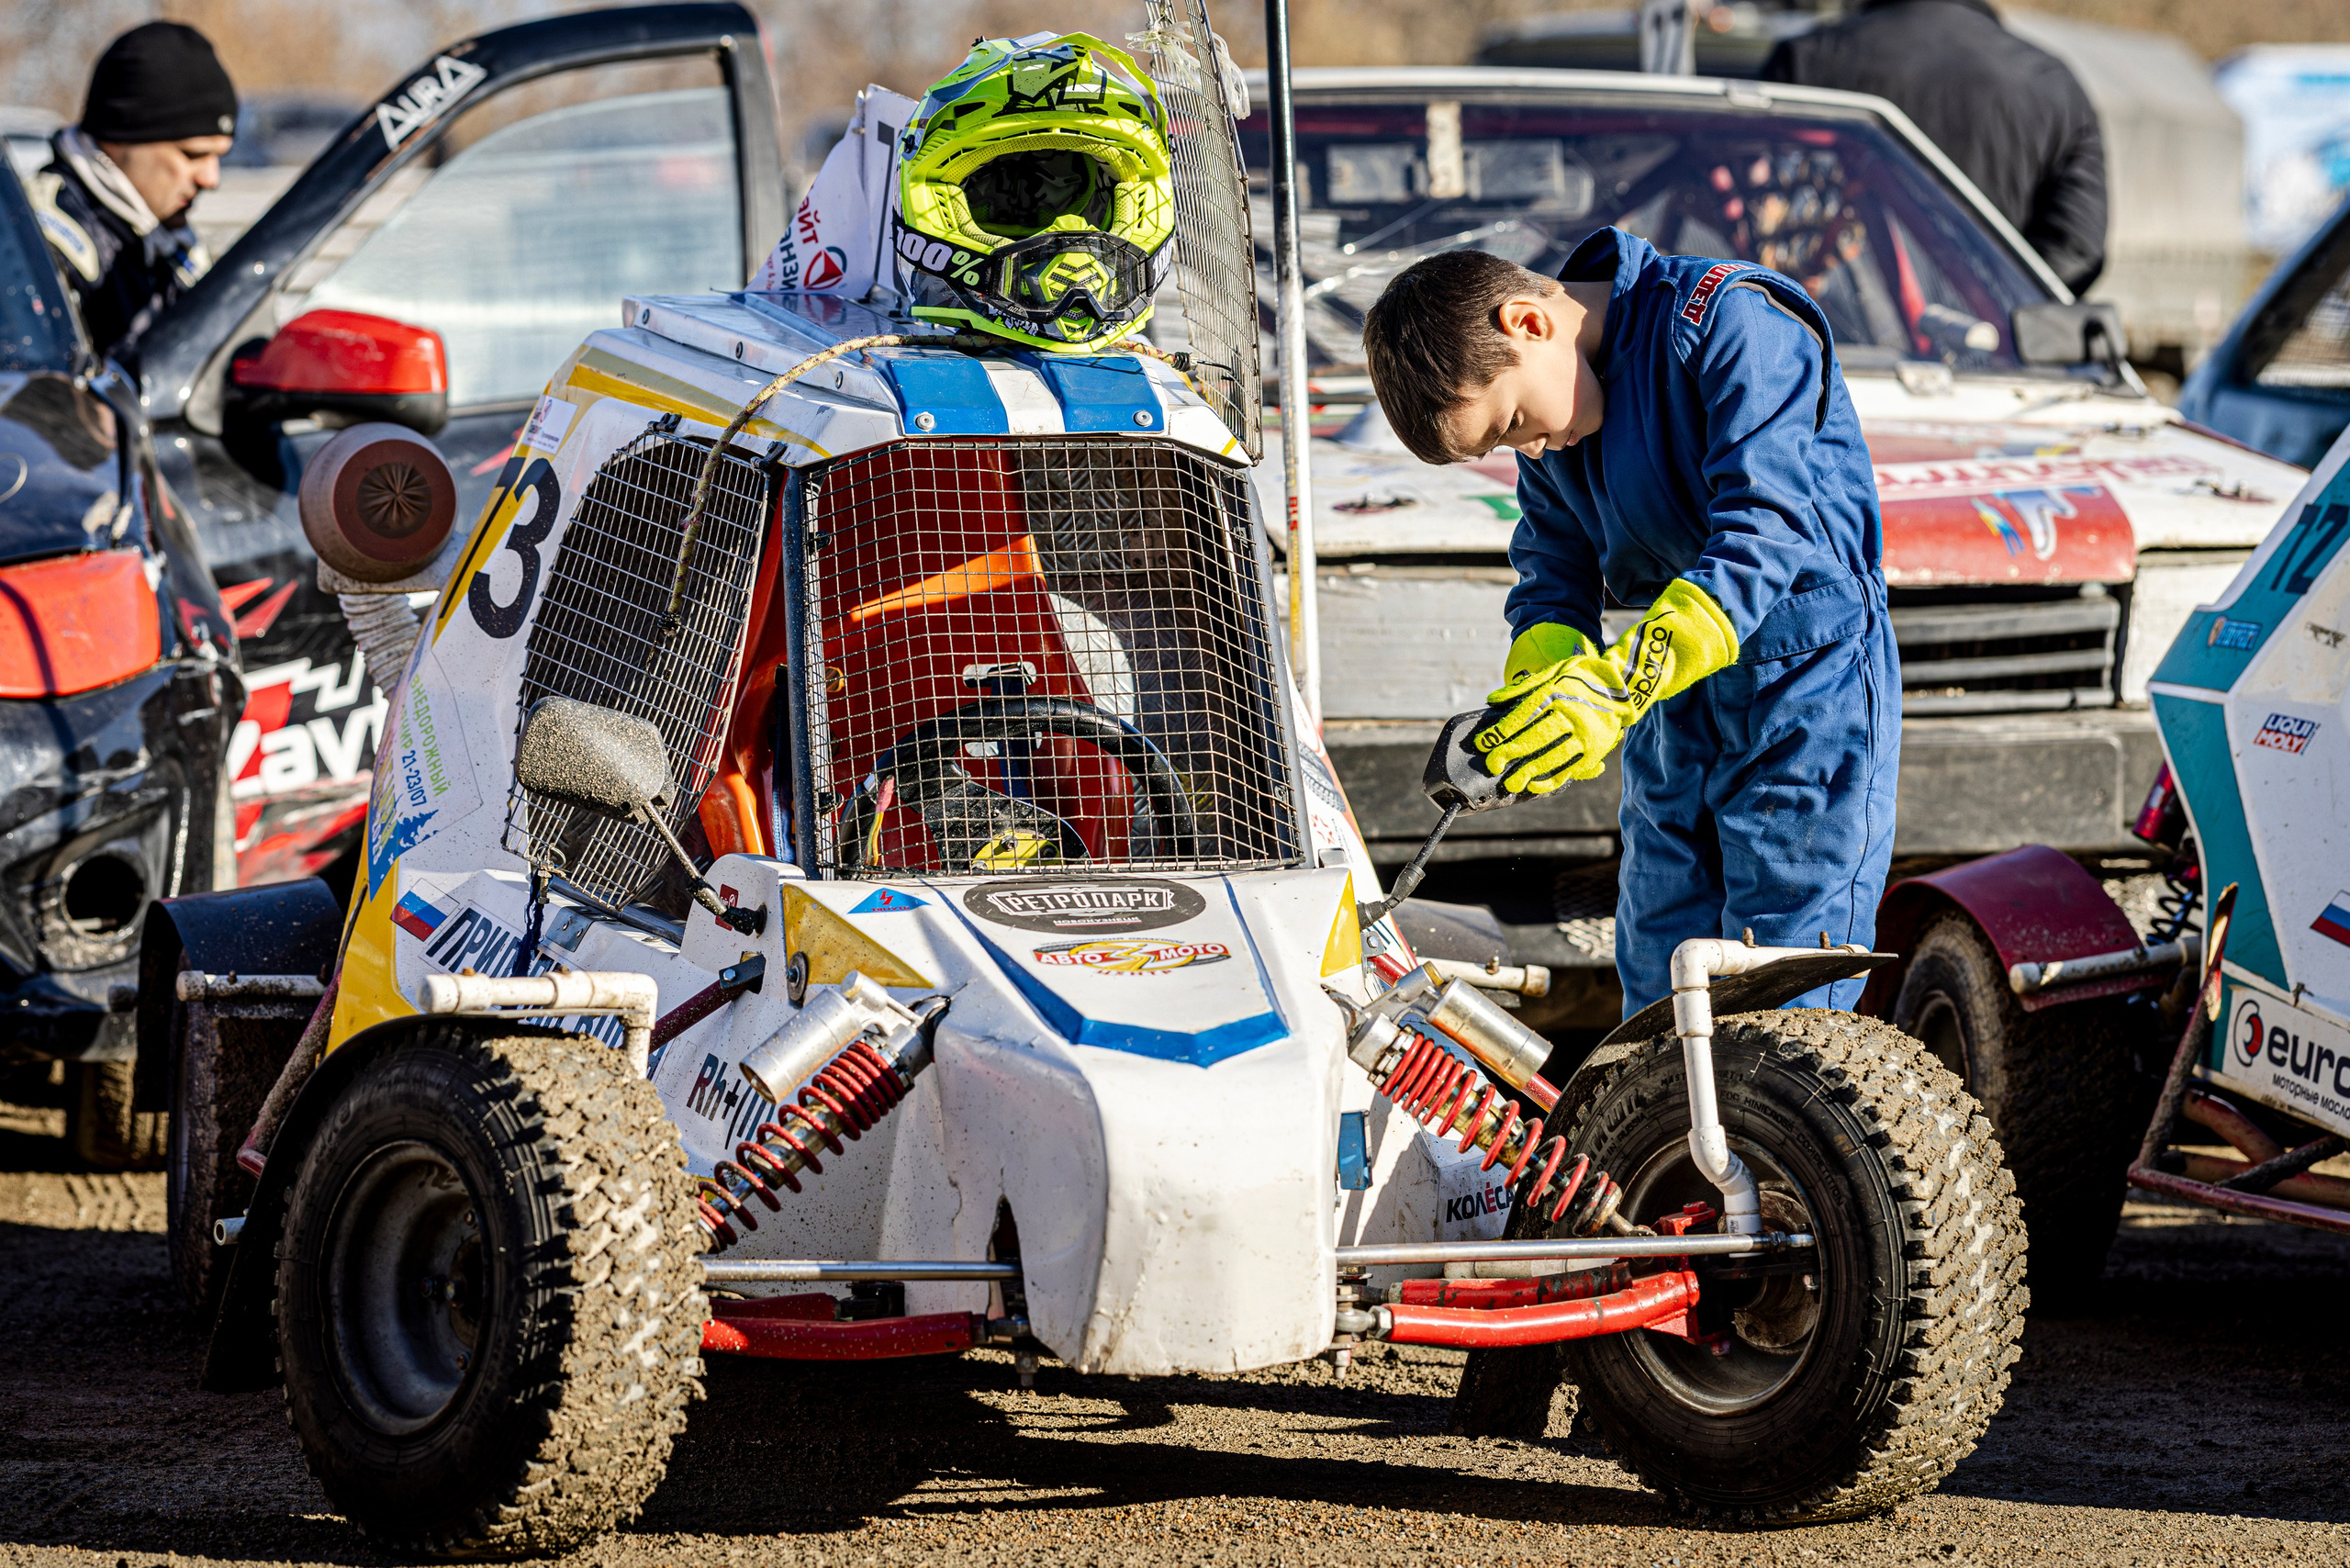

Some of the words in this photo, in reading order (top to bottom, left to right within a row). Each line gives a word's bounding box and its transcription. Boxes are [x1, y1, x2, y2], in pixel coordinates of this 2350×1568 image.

[375, 55, 487, 152] AURA
[896, 225, 983, 286] 100%
[1633, 626, 1669, 708] sparco
[2266, 715, 2313, 737] LIQUI
[2256, 730, 2304, 750] MOLY
[402, 750, 427, 808] 21-23/07
[1005, 890, 1160, 912] РЕТРОПАРК
[1039, 952, 1102, 965] АВТО
[1158, 943, 1226, 961] МОТО
[1661, 1072, 1686, 1086] MAST
[1617, 1112, 1648, 1140] RUSSIA
